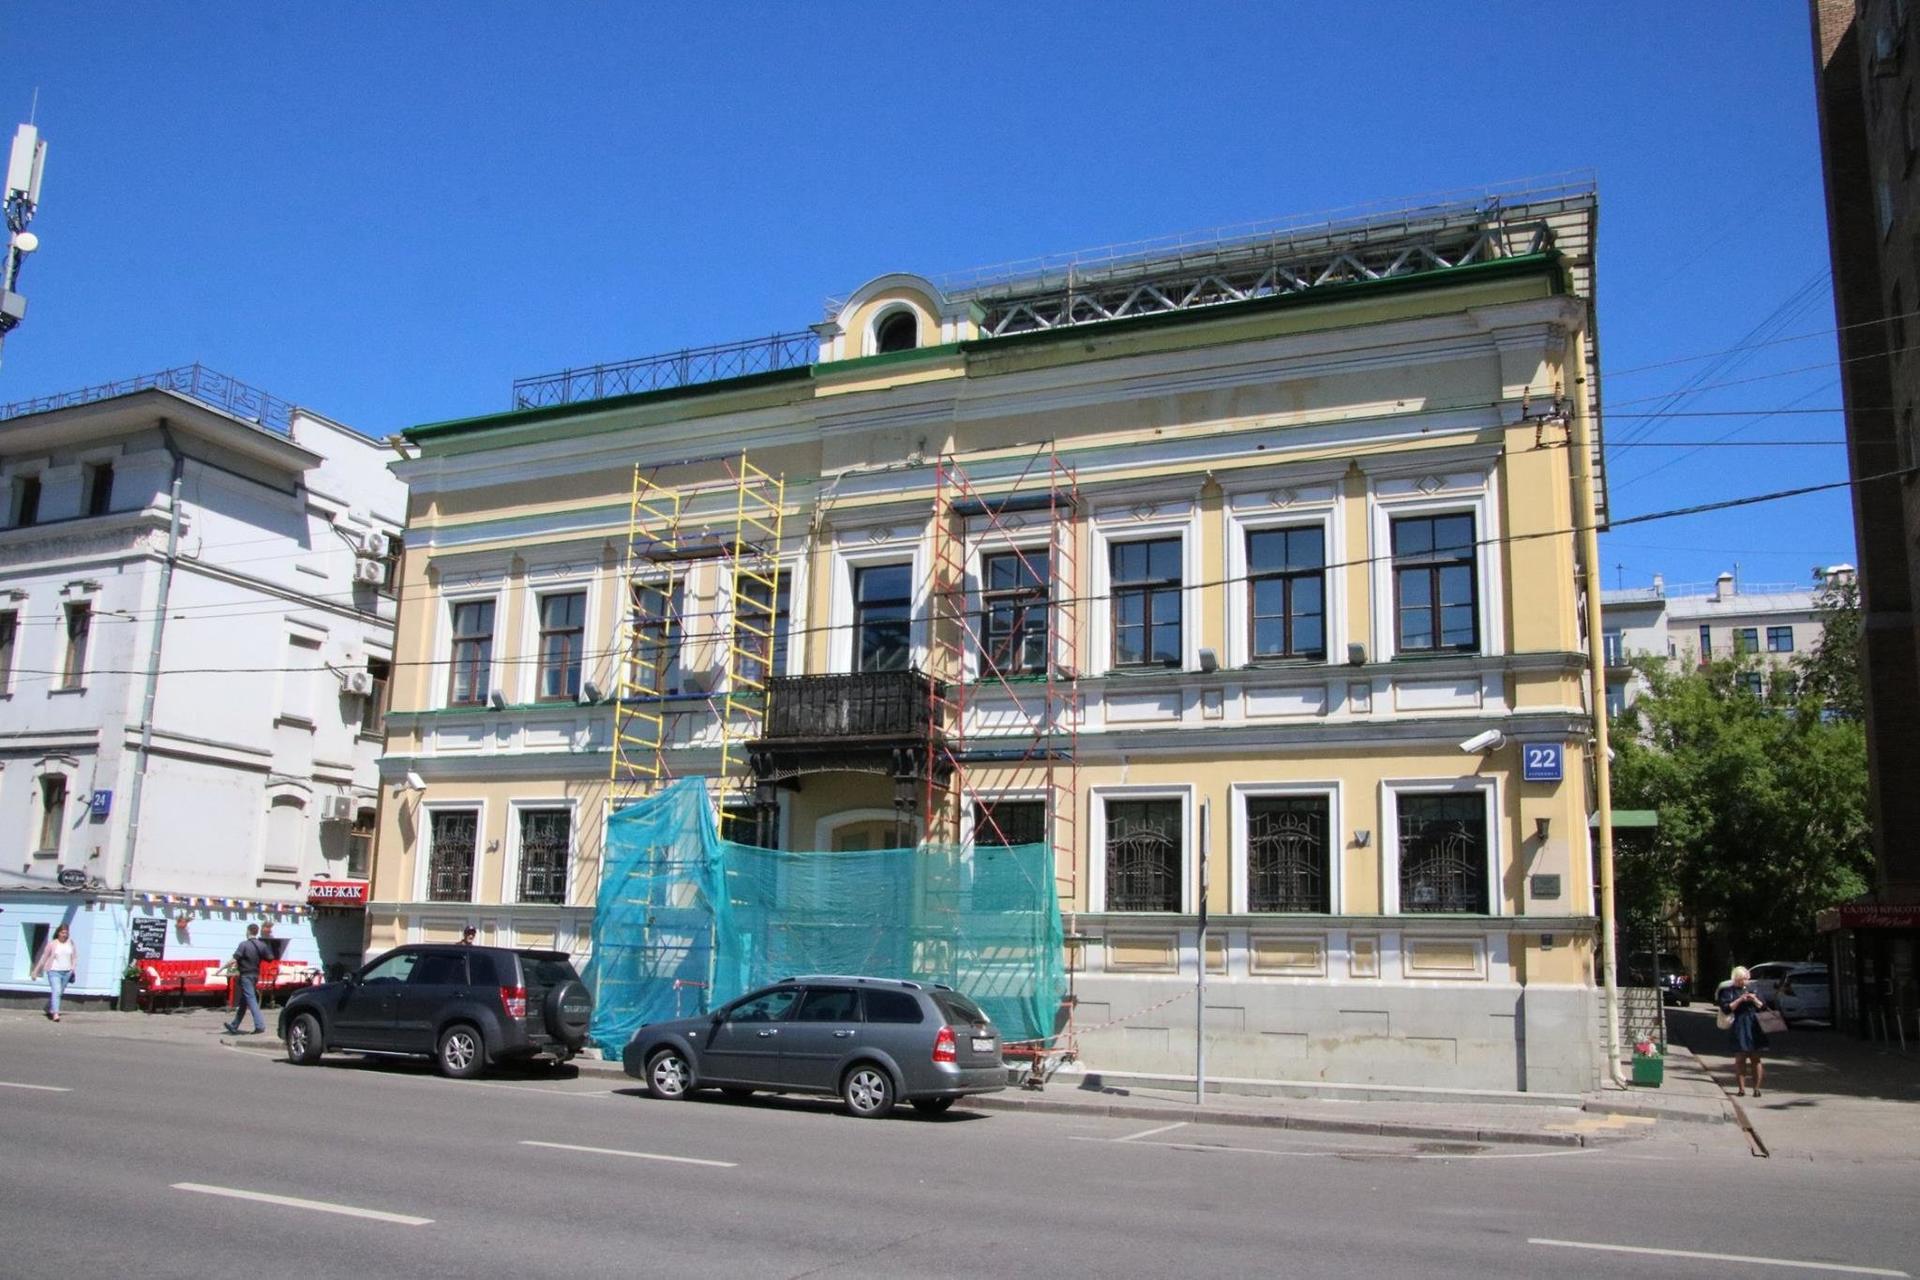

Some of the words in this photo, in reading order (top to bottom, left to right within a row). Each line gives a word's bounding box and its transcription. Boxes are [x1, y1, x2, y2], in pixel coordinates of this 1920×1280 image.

[1530, 749, 1555, 767] 22
[94, 793, 106, 806] 24
[307, 886, 362, 897] ЖАН-ЖАК
[1879, 905, 1920, 914] КРАСОТ
